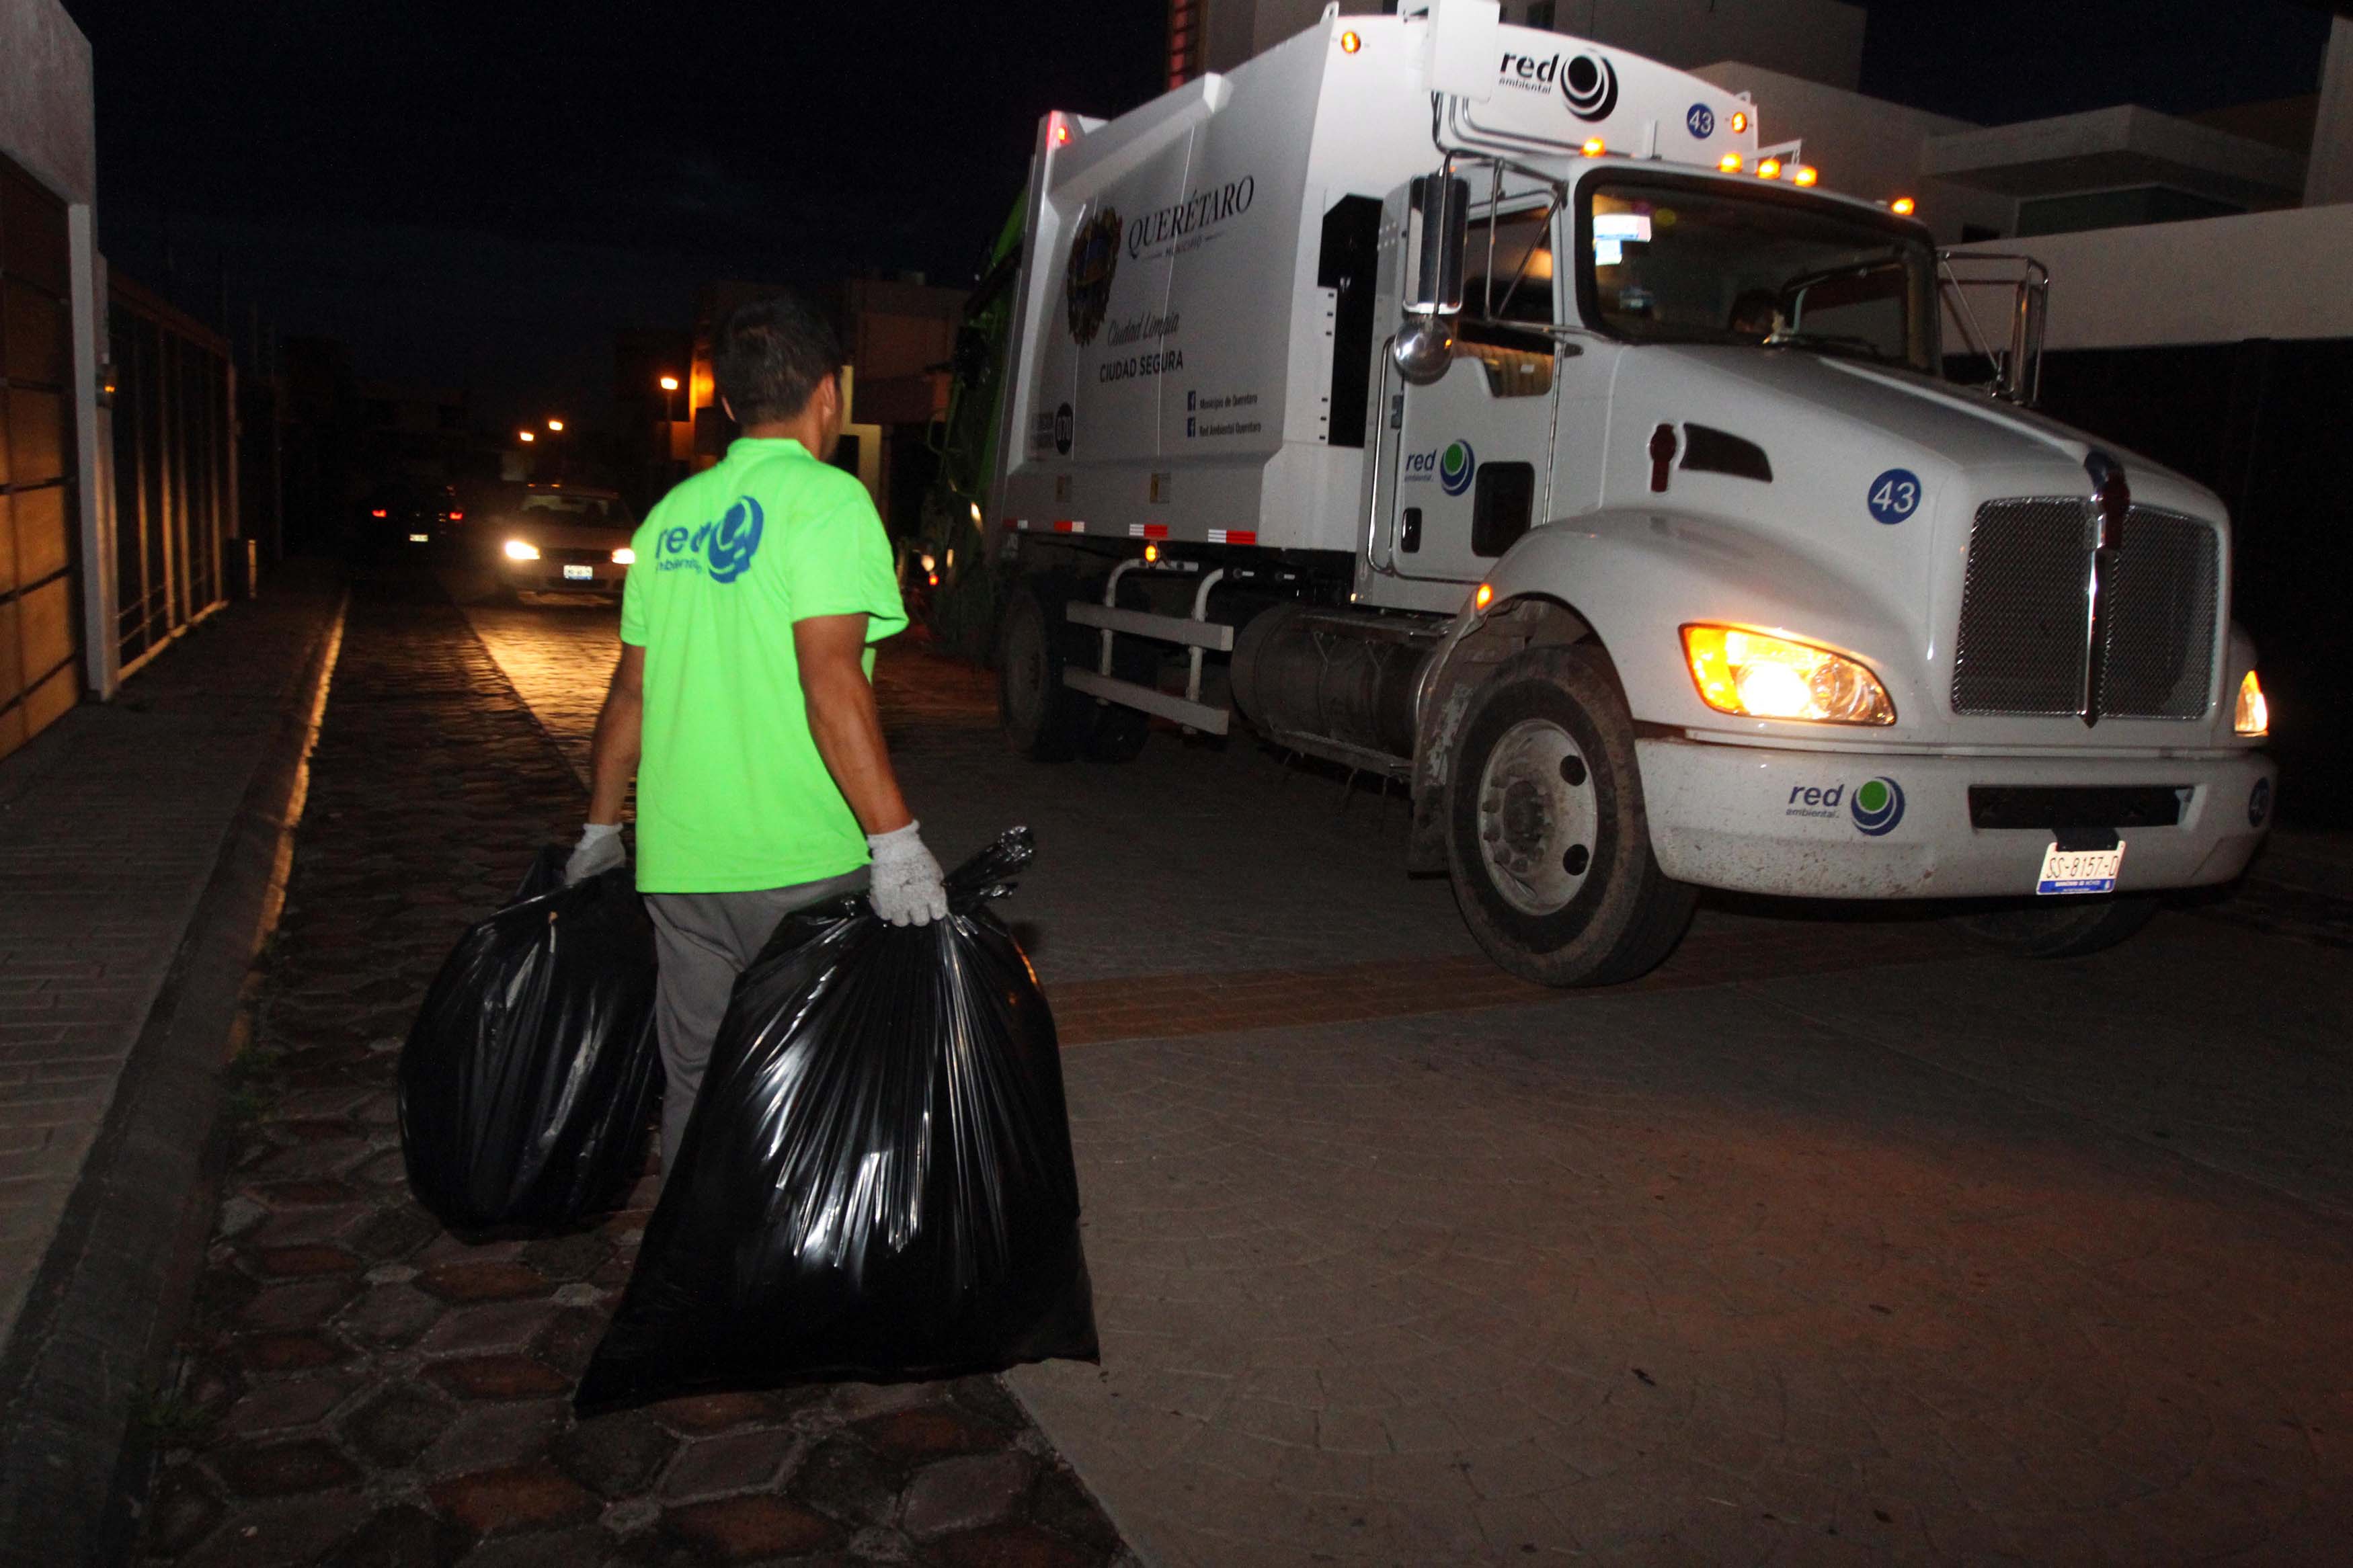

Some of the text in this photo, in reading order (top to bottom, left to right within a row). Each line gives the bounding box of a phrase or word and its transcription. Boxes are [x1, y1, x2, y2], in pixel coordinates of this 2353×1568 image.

[1500, 52, 1560, 82] red
[1689, 110, 1712, 134] 43
[1129, 175, 1254, 259] QUERÉTARO
[1100, 349, 1183, 383] CIUDAD SEGURA
[1406, 448, 1437, 472] red
[1872, 480, 1915, 513] 43
[1789, 784, 1845, 807] red
